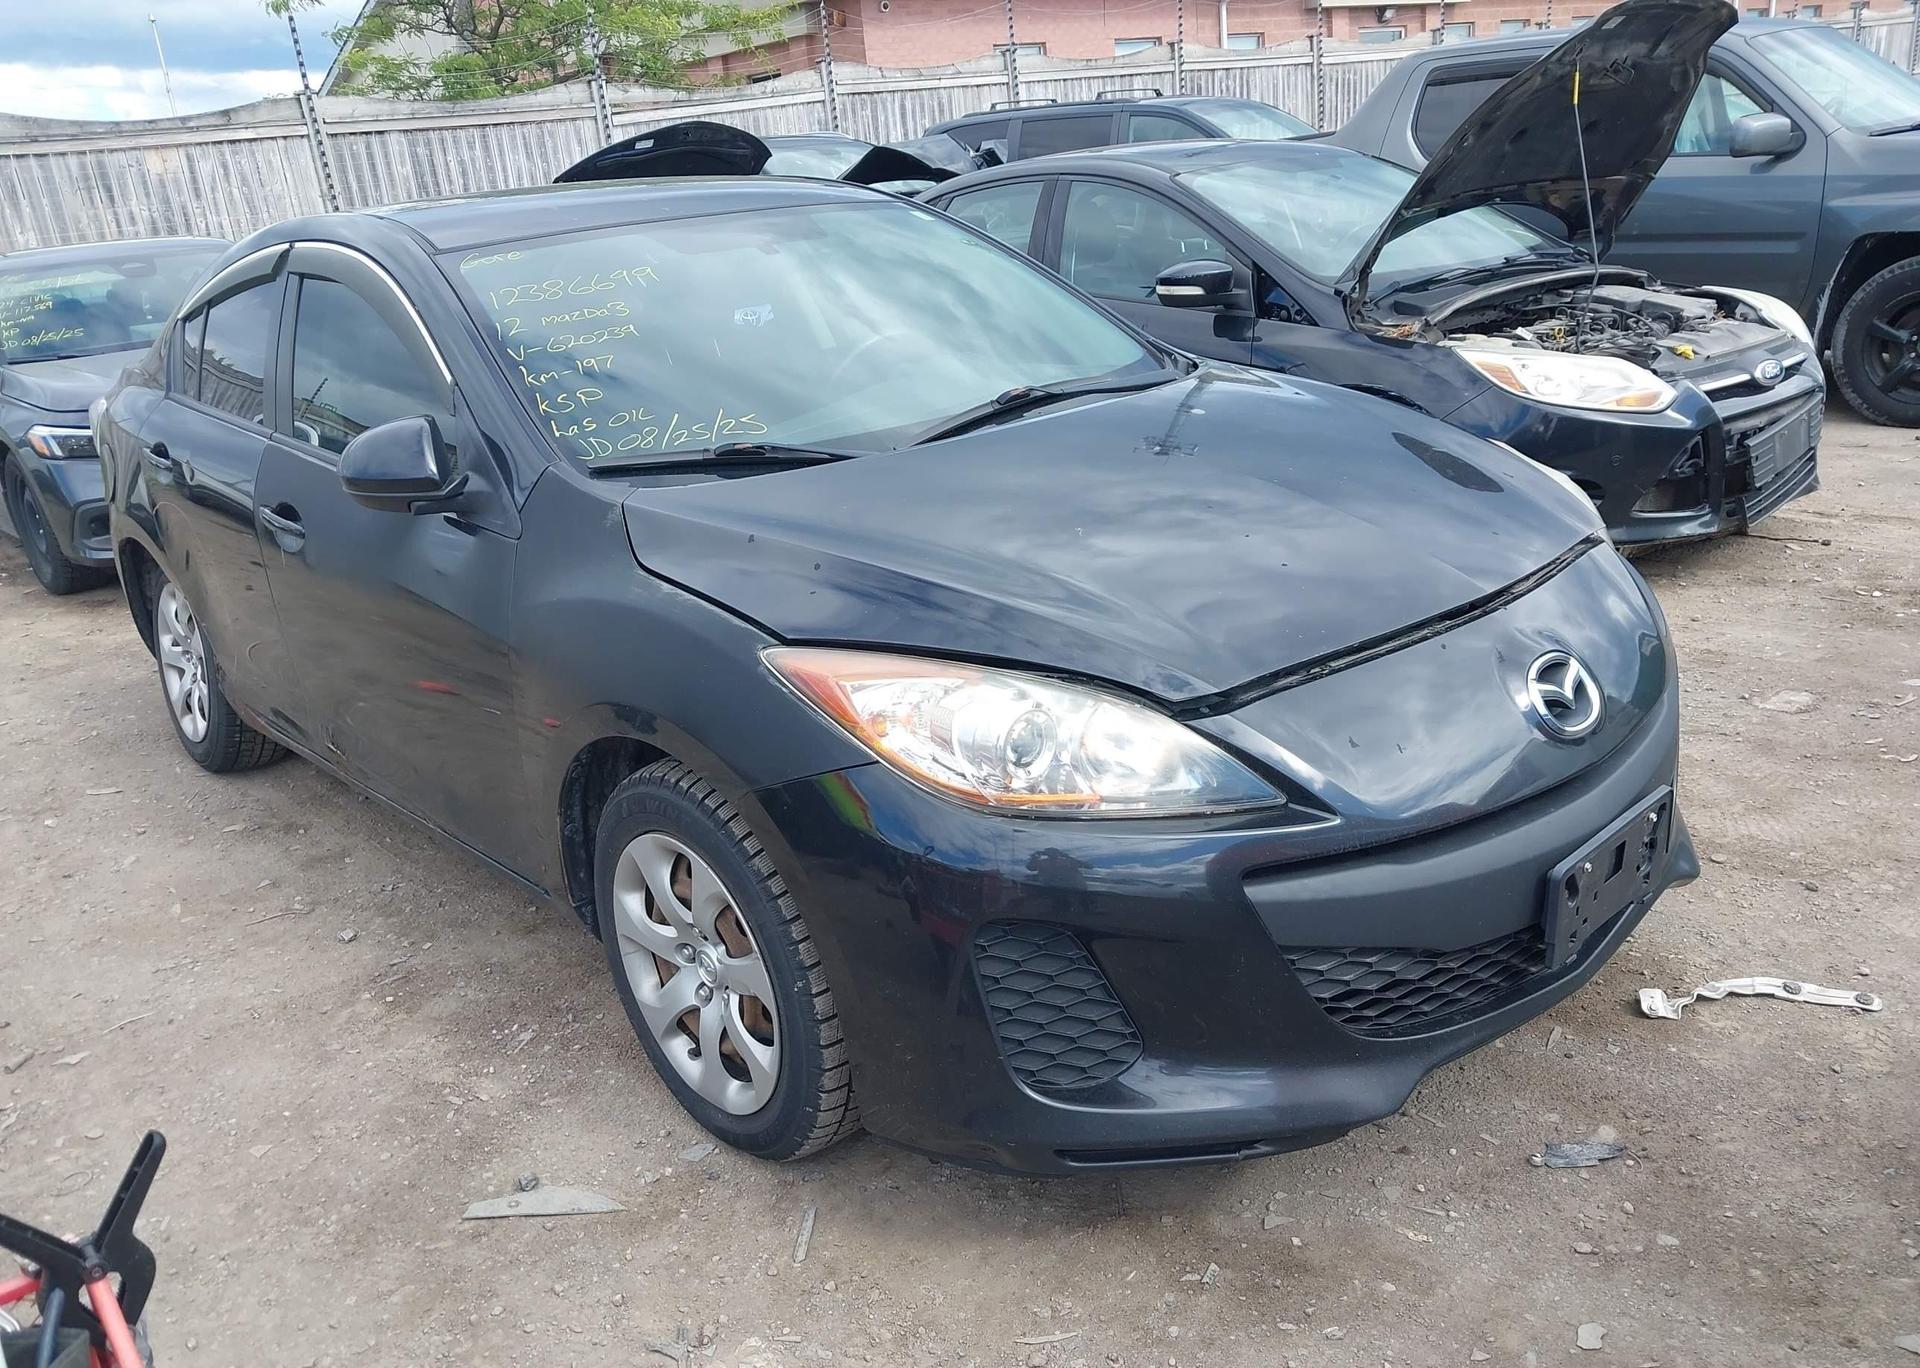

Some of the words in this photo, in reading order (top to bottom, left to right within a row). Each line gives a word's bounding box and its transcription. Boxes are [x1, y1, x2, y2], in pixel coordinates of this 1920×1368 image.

[495, 317, 528, 341] 12
[506, 324, 640, 361] V-620239
[617, 407, 768, 451] 08/25/25
